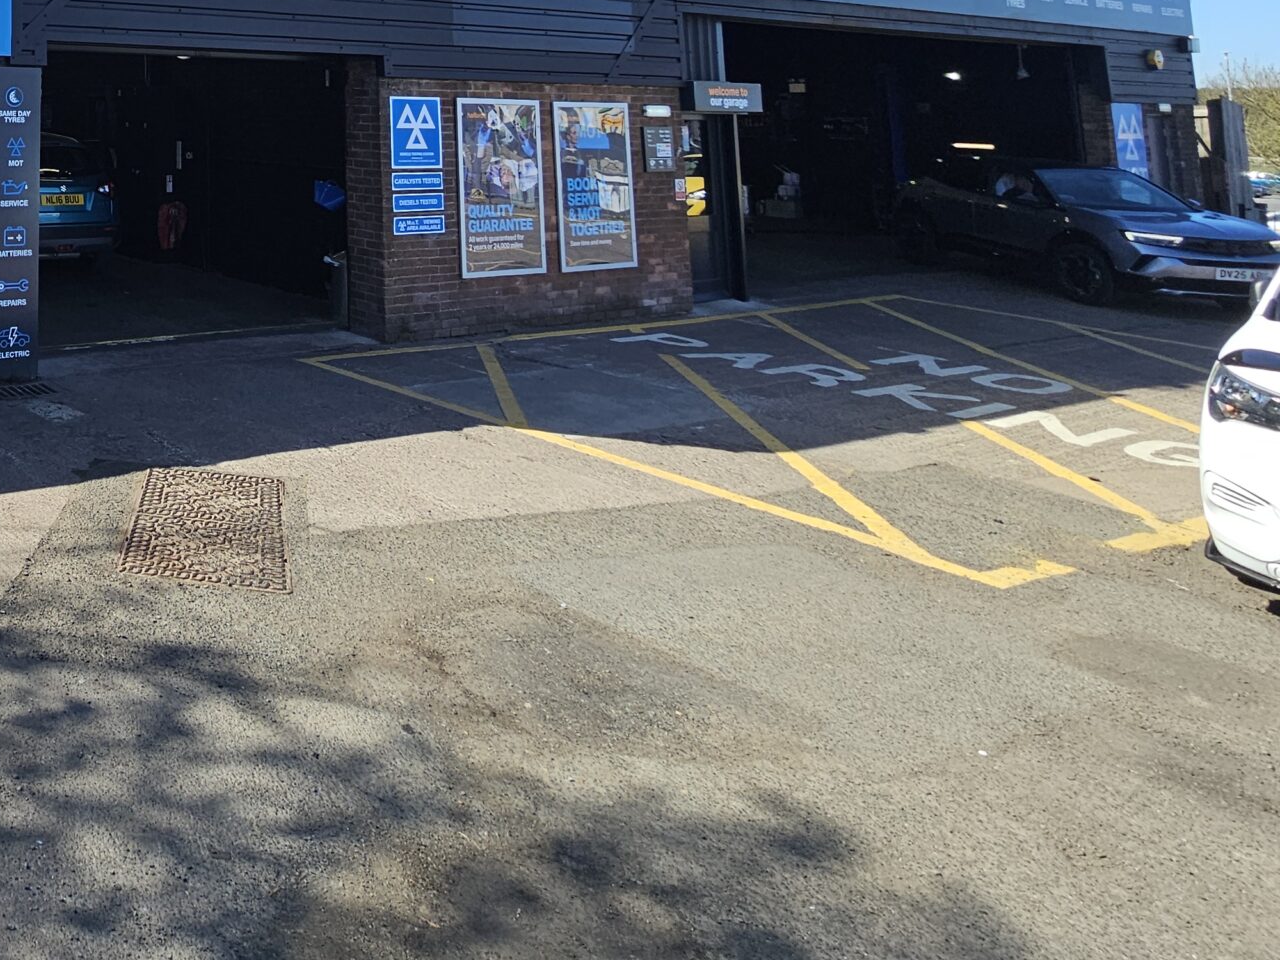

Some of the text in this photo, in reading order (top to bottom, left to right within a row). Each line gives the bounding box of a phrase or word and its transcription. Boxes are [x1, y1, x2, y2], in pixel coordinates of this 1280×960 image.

[708, 87, 748, 97] welcome to
[710, 98, 748, 108] our garage
[567, 177, 597, 192] BOOK
[567, 191, 611, 206] SERVICE
[468, 204, 514, 219] QUALITY
[569, 206, 601, 221] & MOT
[468, 218, 534, 233] GUARANTEE
[570, 220, 625, 237] TOGETHER
[868, 346, 1073, 394] NO
[610, 332, 1200, 467] PARKING
